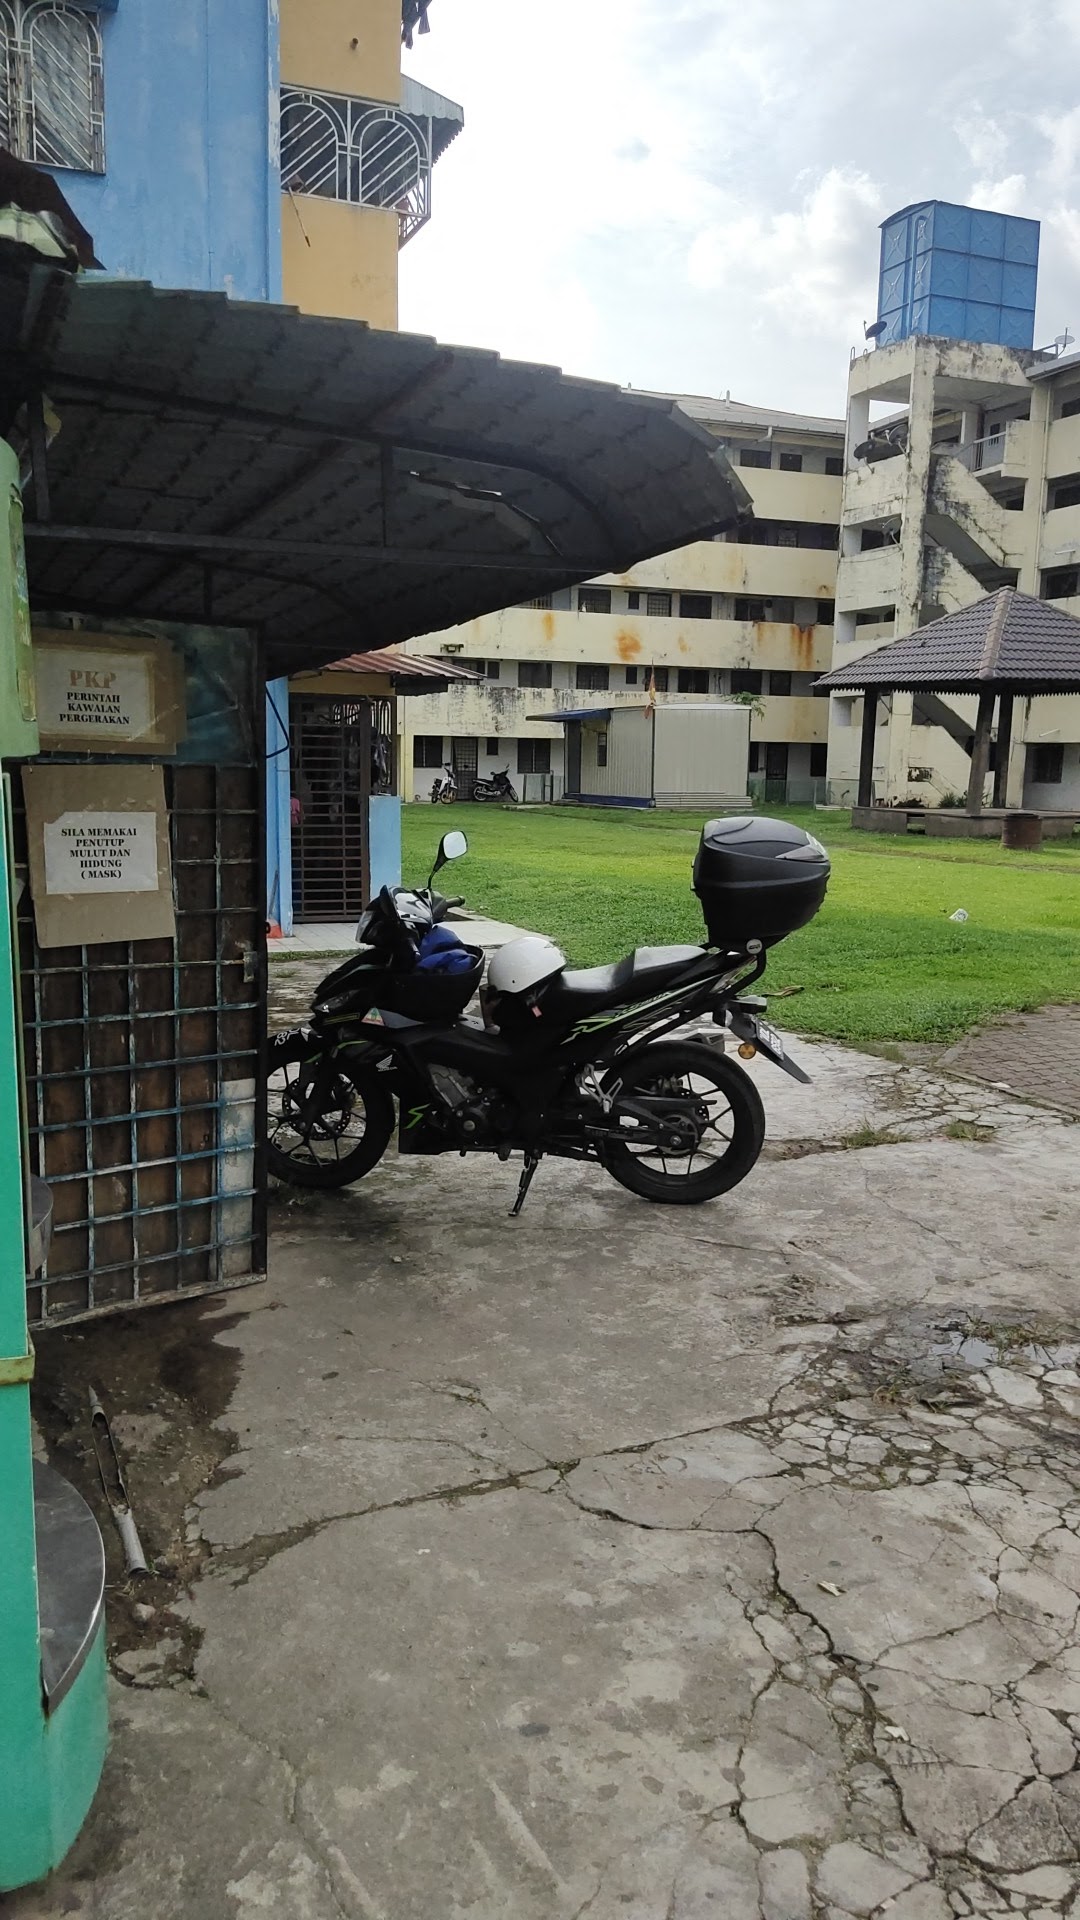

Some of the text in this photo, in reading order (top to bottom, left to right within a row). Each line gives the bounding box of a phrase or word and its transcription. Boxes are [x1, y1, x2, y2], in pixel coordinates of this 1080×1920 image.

[69, 669, 117, 689] PKP
[67, 692, 120, 703] PERINTAH
[68, 703, 120, 713] KAWALAN
[59, 714, 130, 725] PERGERAKAN
[61, 828, 137, 837] SILA MEMAKAI
[76, 839, 125, 847] PENUTUP
[70, 849, 131, 858] MULUT DAN
[80, 859, 122, 868] HIDUNG
